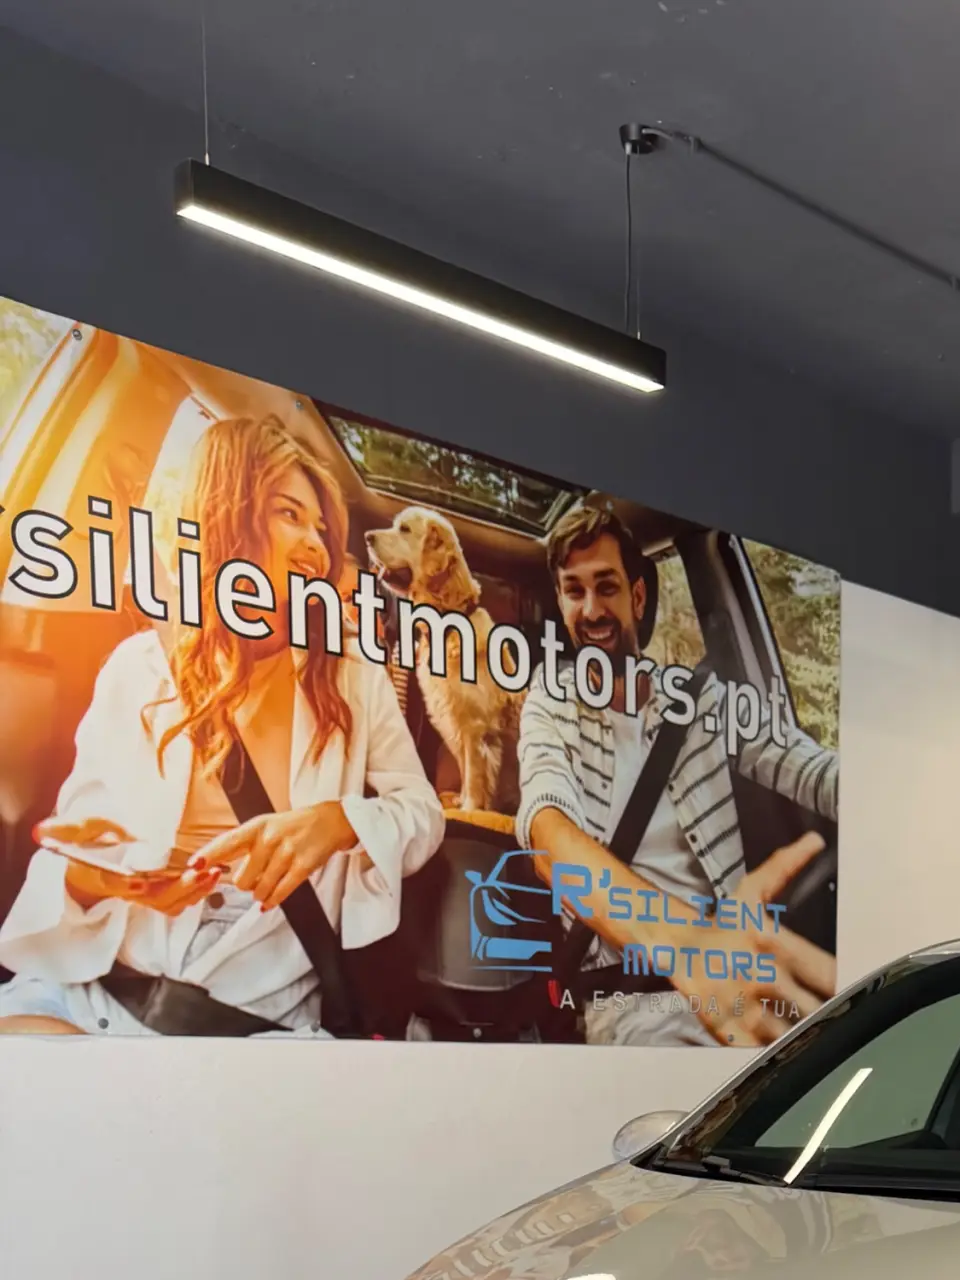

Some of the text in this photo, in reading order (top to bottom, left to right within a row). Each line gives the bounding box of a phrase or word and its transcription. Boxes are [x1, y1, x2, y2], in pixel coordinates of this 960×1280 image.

[0, 495, 788, 756] silientmotors.pt
[551, 862, 787, 934] R'SILIENT
[622, 943, 777, 984] MOTORS
[559, 989, 800, 1018] A ESTRADA É TUA
